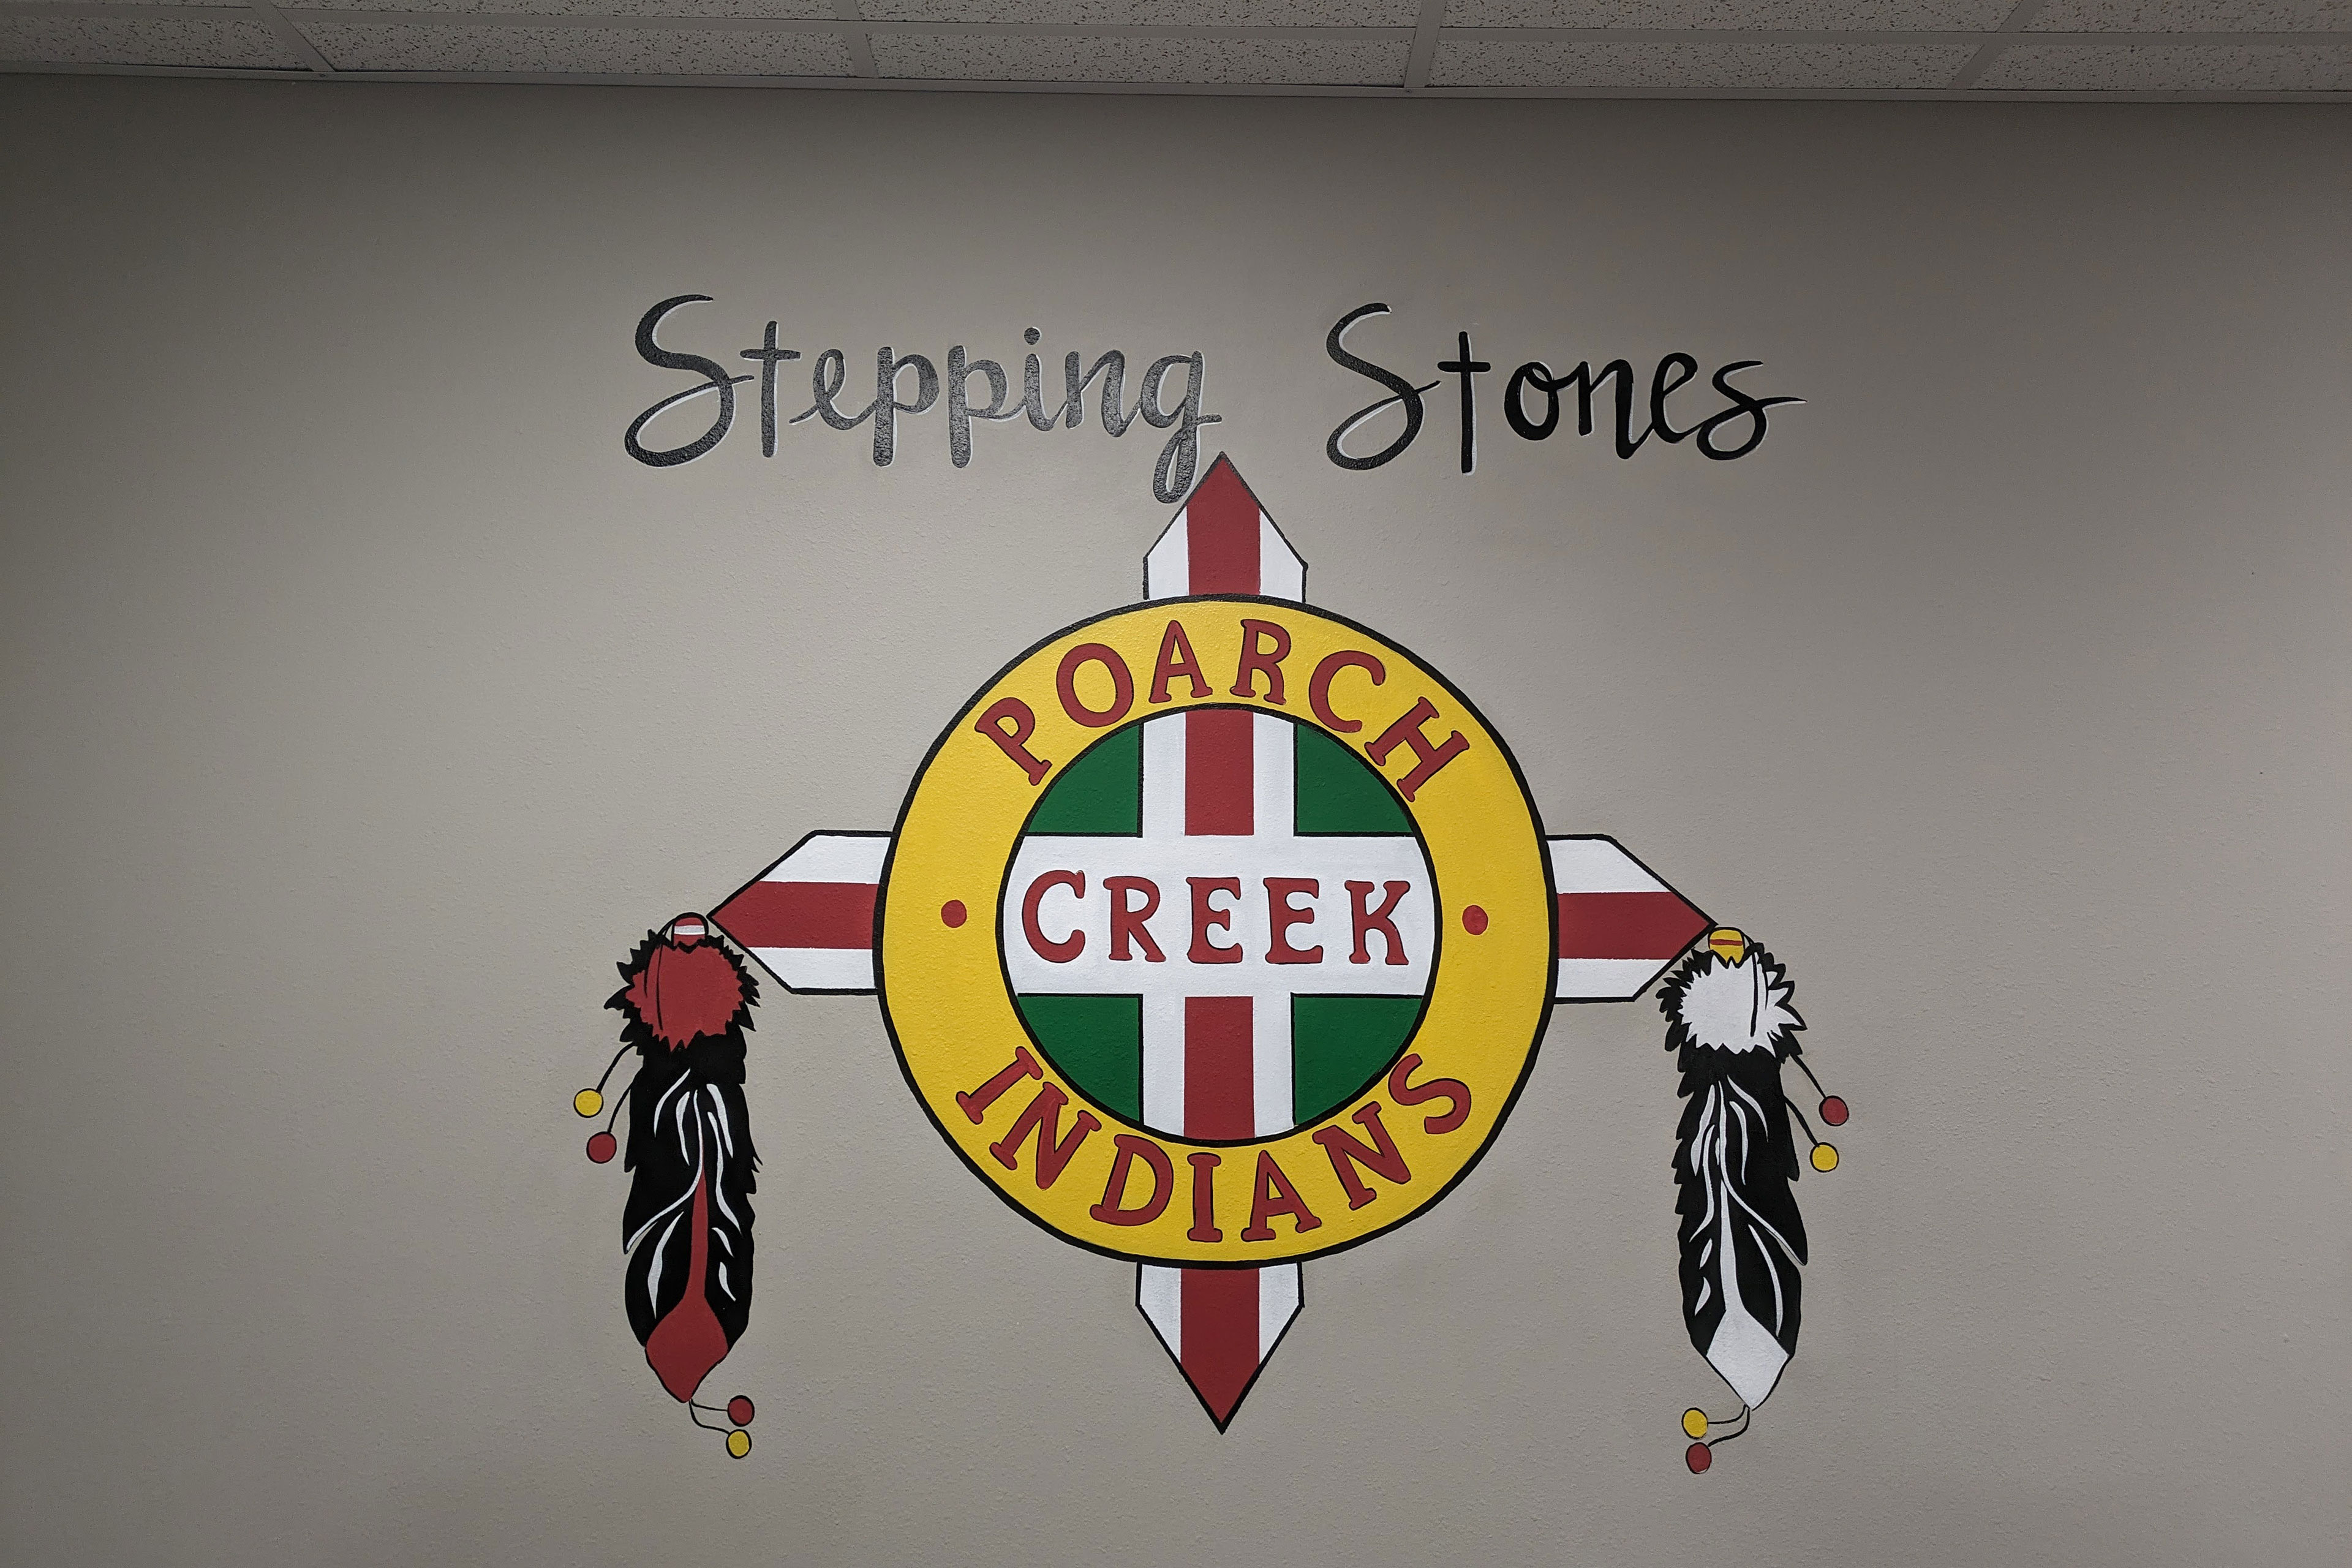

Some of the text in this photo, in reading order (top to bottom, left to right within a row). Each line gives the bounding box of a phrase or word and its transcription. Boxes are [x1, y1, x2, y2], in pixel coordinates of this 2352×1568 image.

[625, 293, 1807, 503] Stepping Stones
[975, 619, 1470, 802] POARCH
[1021, 870, 1411, 965] CREEK
[956, 1046, 1472, 1242] INDIANS
